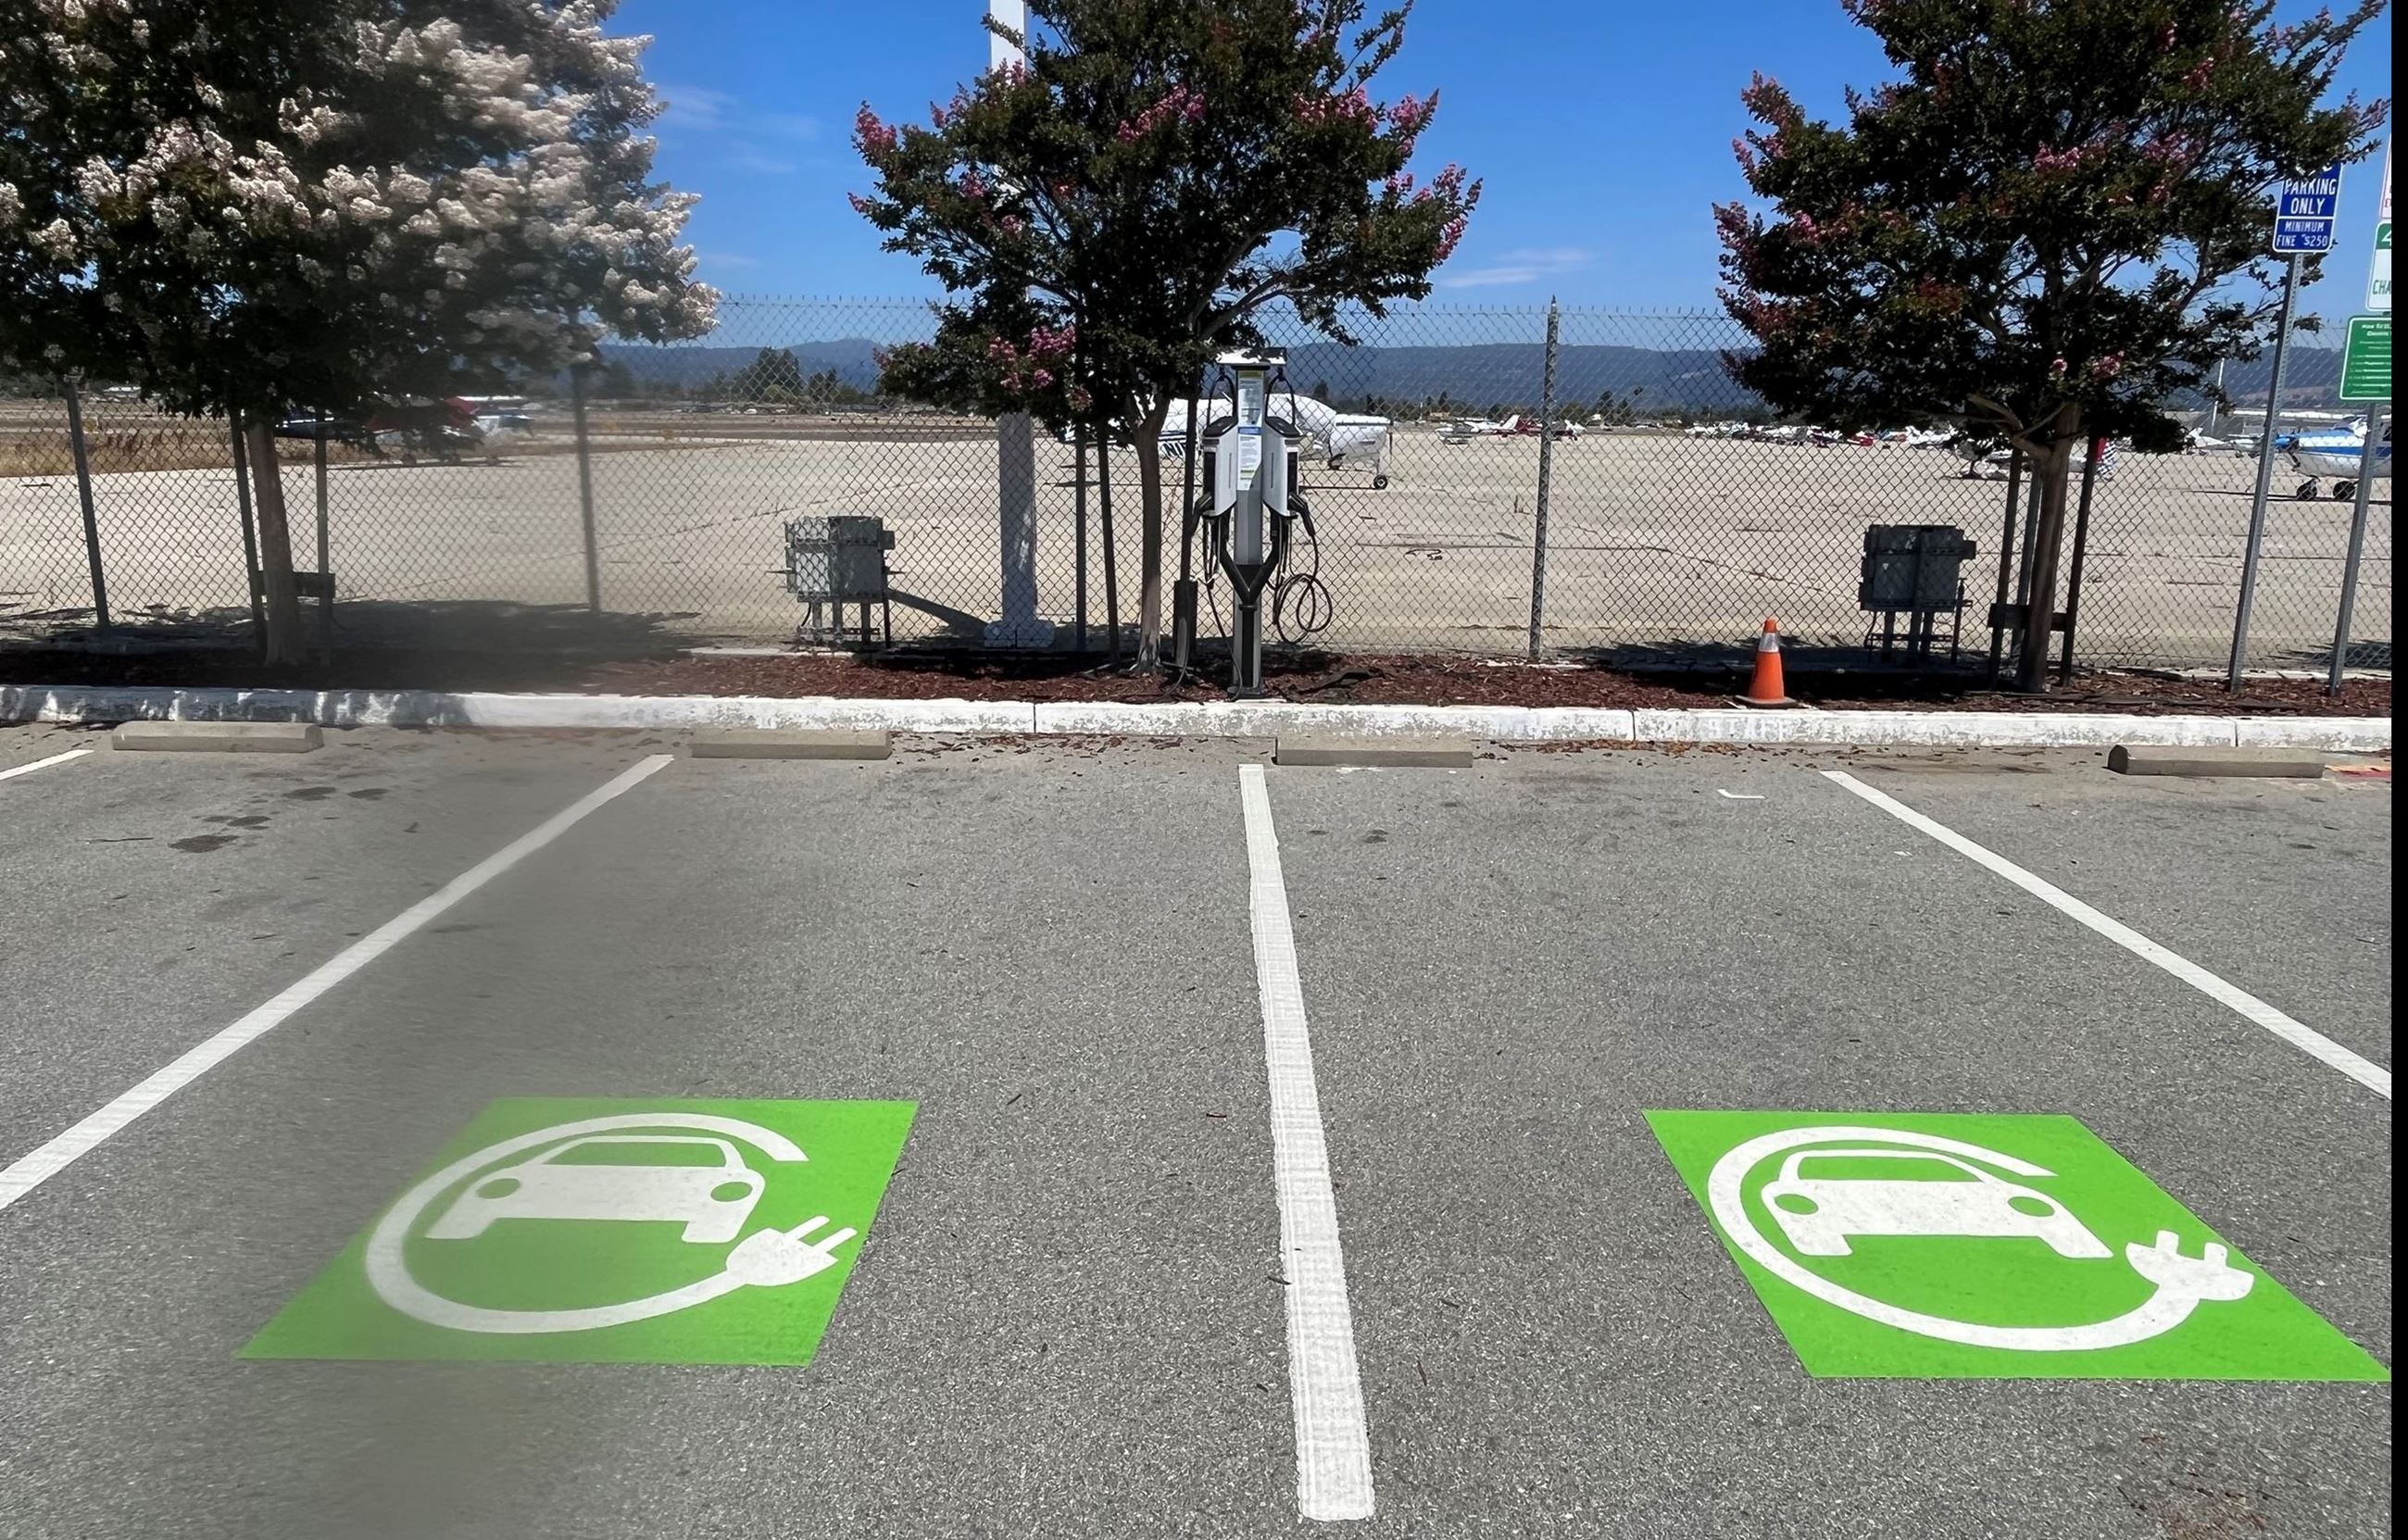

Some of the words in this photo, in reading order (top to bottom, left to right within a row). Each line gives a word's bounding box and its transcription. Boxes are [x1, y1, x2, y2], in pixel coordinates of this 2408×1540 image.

[2284, 178, 2337, 195] PARKING
[2290, 197, 2326, 215] ONLY
[2284, 220, 2326, 232] MINIMUM
[2276, 234, 2297, 247] FINE
